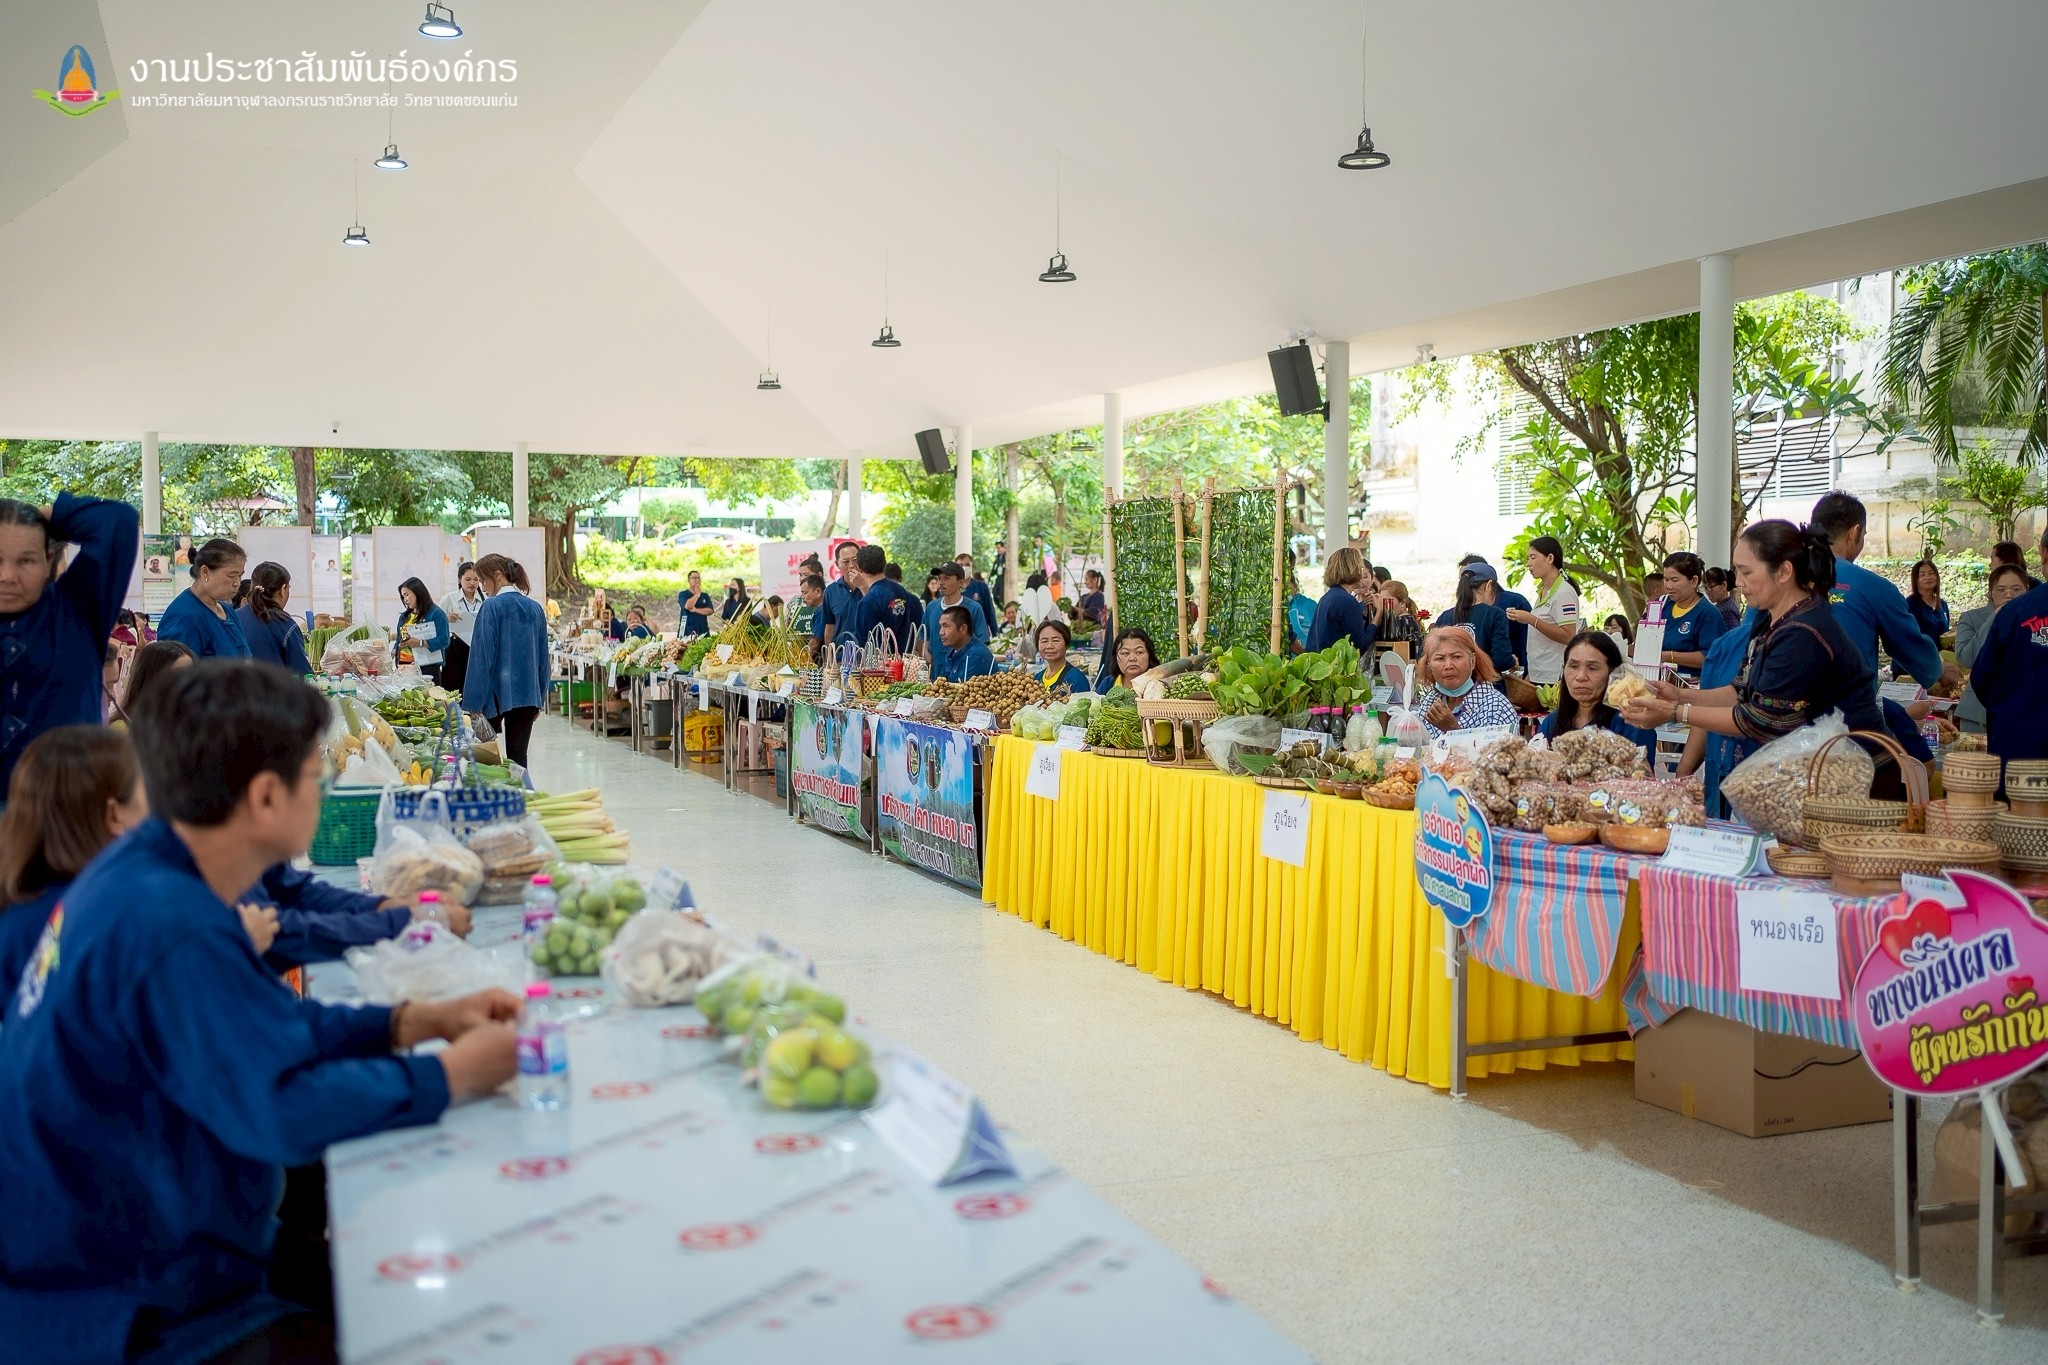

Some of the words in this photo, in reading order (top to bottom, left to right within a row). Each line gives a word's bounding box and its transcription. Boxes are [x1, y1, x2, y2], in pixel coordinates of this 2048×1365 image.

[931, 812, 958, 843] หนอง
[960, 821, 975, 849] นา
[1273, 809, 1298, 831] ภูเวียง
[1750, 915, 1824, 944] หนองเรือ
[1867, 932, 2016, 1027] ทางนี้มีผล
[1909, 990, 2048, 1084] ผู้คนรักกัน
